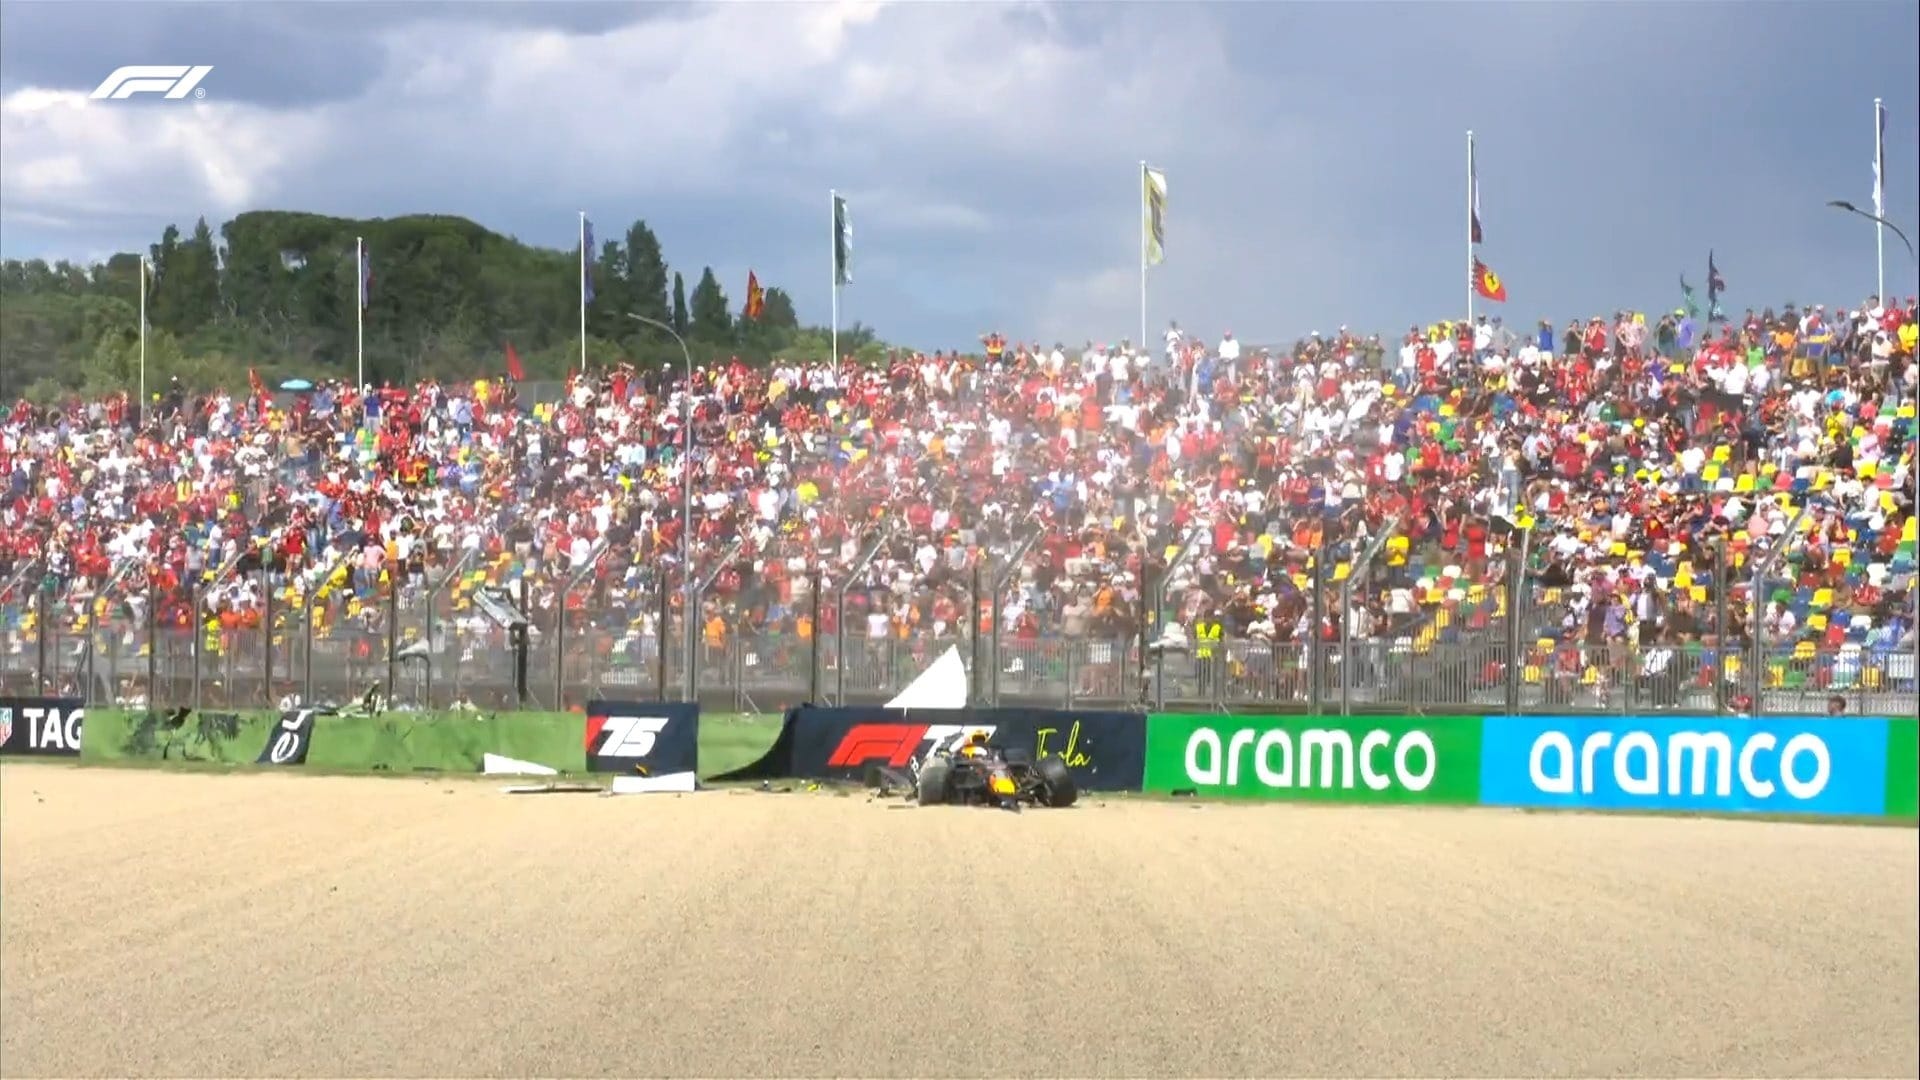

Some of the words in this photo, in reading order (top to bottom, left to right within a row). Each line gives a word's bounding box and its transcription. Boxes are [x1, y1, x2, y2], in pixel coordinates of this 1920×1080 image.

[22, 707, 84, 750] TAG
[598, 716, 669, 756] 75
[1185, 727, 1436, 791] aramco
[1529, 731, 1831, 799] aramco
